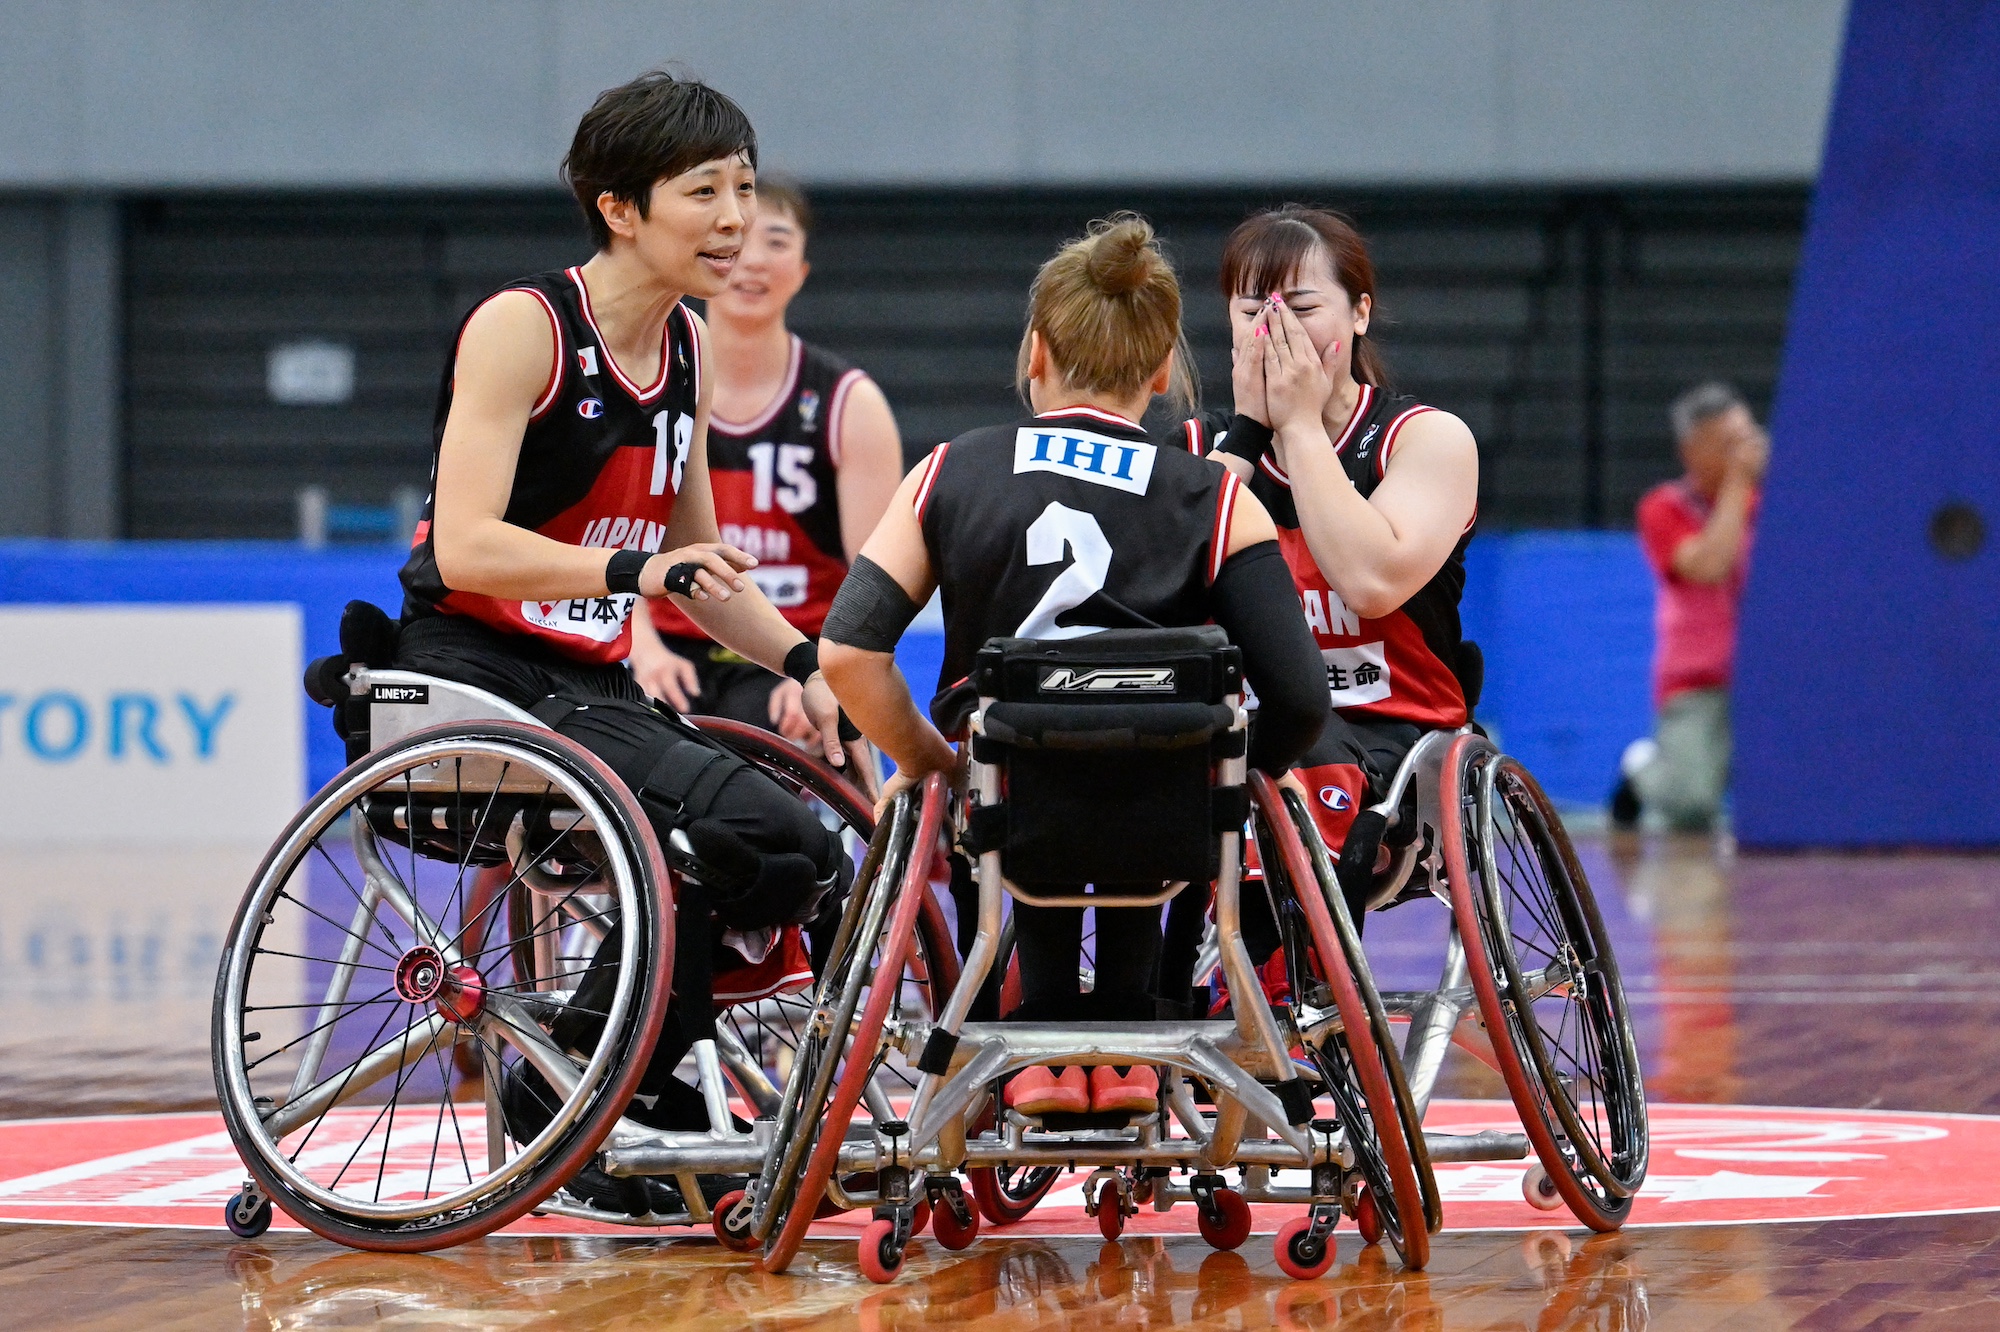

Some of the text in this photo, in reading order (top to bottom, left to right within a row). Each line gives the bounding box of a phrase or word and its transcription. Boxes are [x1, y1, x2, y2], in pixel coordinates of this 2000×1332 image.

[650, 410, 694, 495] 18
[1029, 433, 1140, 481] IHI
[747, 442, 818, 514] 15
[721, 523, 790, 561] PAN
[1014, 501, 1113, 640] 2
[1299, 590, 1360, 636] AN
[375, 688, 424, 700] LINEヤフー
[1326, 662, 1381, 690] 生命
